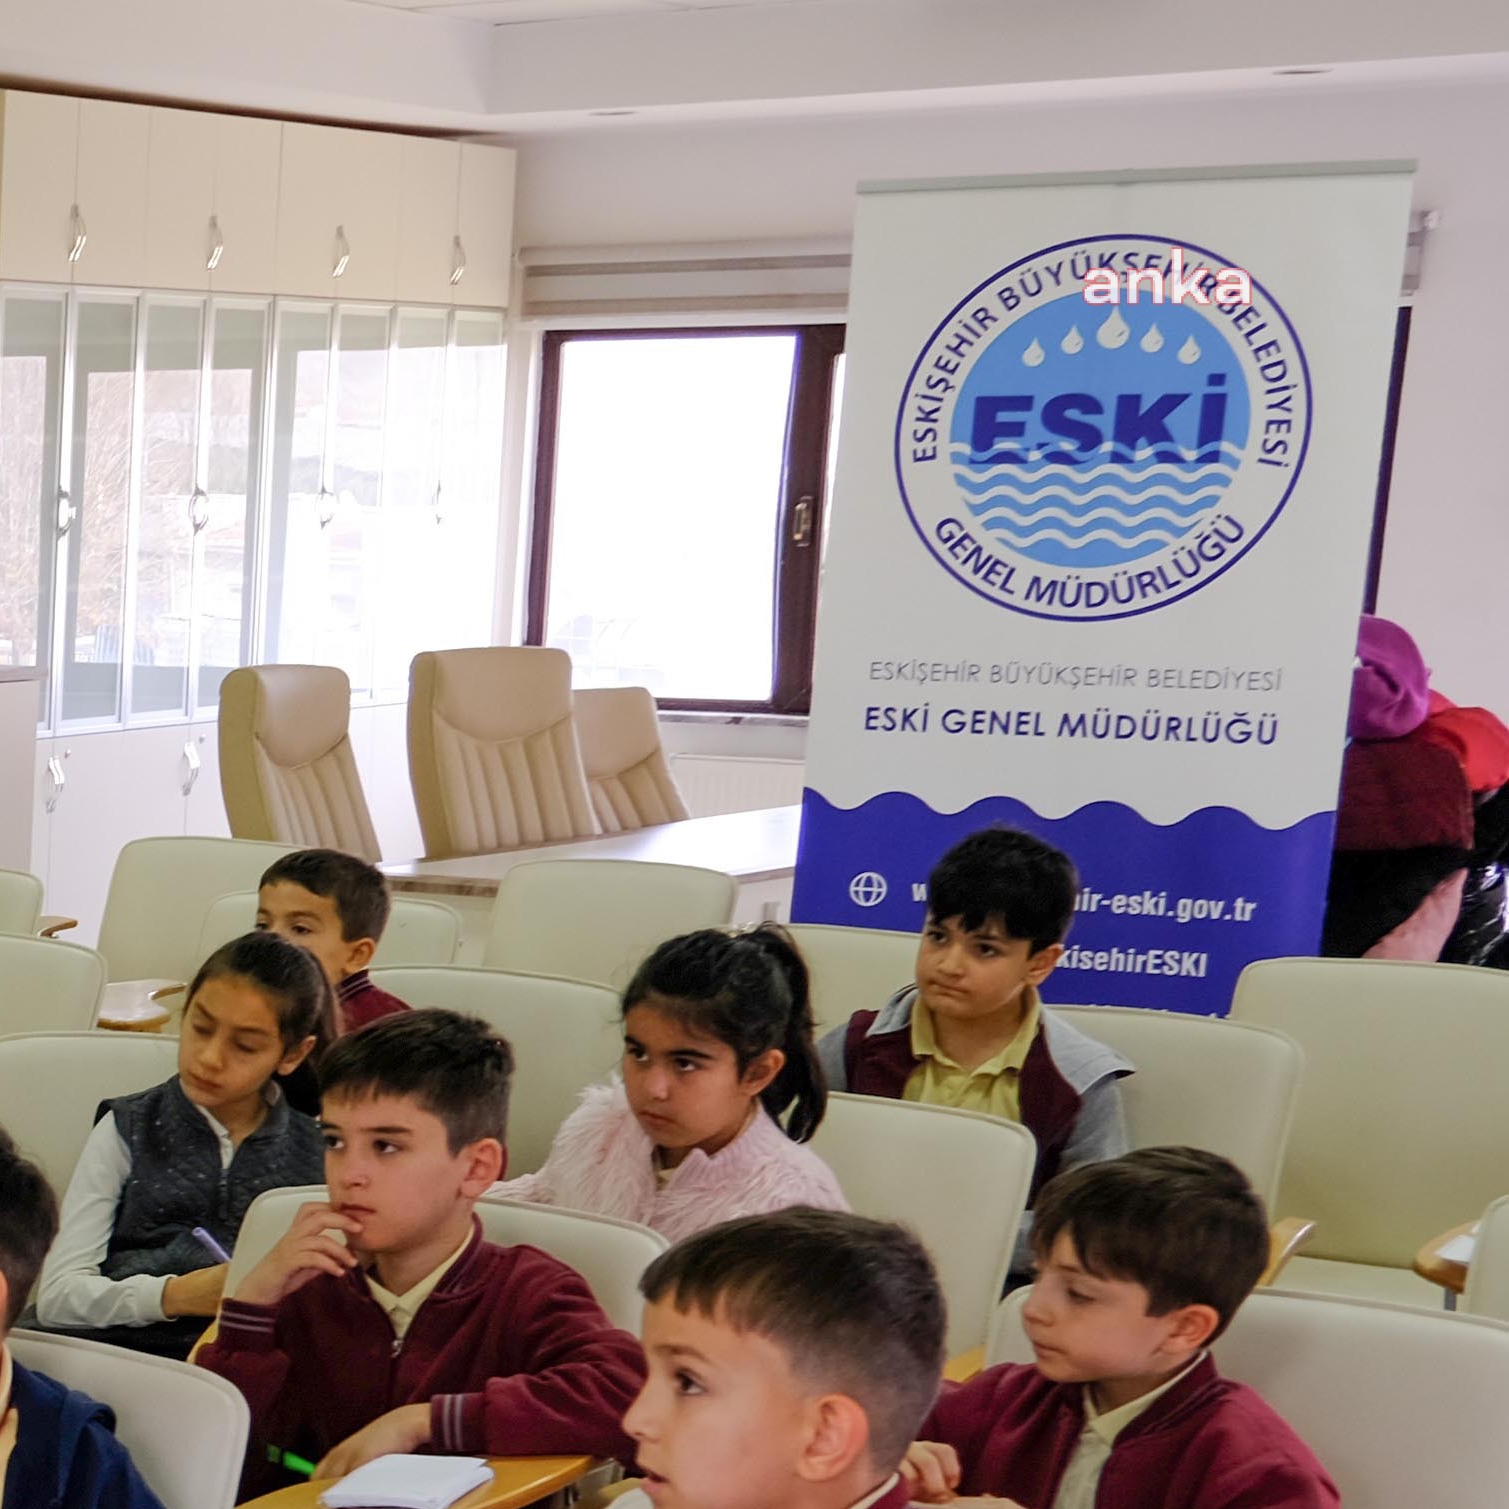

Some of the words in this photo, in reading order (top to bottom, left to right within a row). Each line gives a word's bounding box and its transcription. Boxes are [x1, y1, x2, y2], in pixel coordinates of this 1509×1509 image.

[913, 307, 999, 463] ESKİŞEHİR
[968, 373, 1228, 465] ESKİ
[935, 516, 1016, 595] GENEL
[1024, 513, 1246, 609] MÜDÜRLÜĞÜ
[869, 658, 980, 684] ESKİŞEHİR
[989, 661, 1137, 690] BÜYÜKŞEHİR
[1147, 666, 1282, 692] BELEDİYESİ
[864, 702, 930, 733] ESKİ
[941, 707, 1046, 737] GENEL
[1057, 707, 1279, 745] MÜDÜRLÜĞÜ
